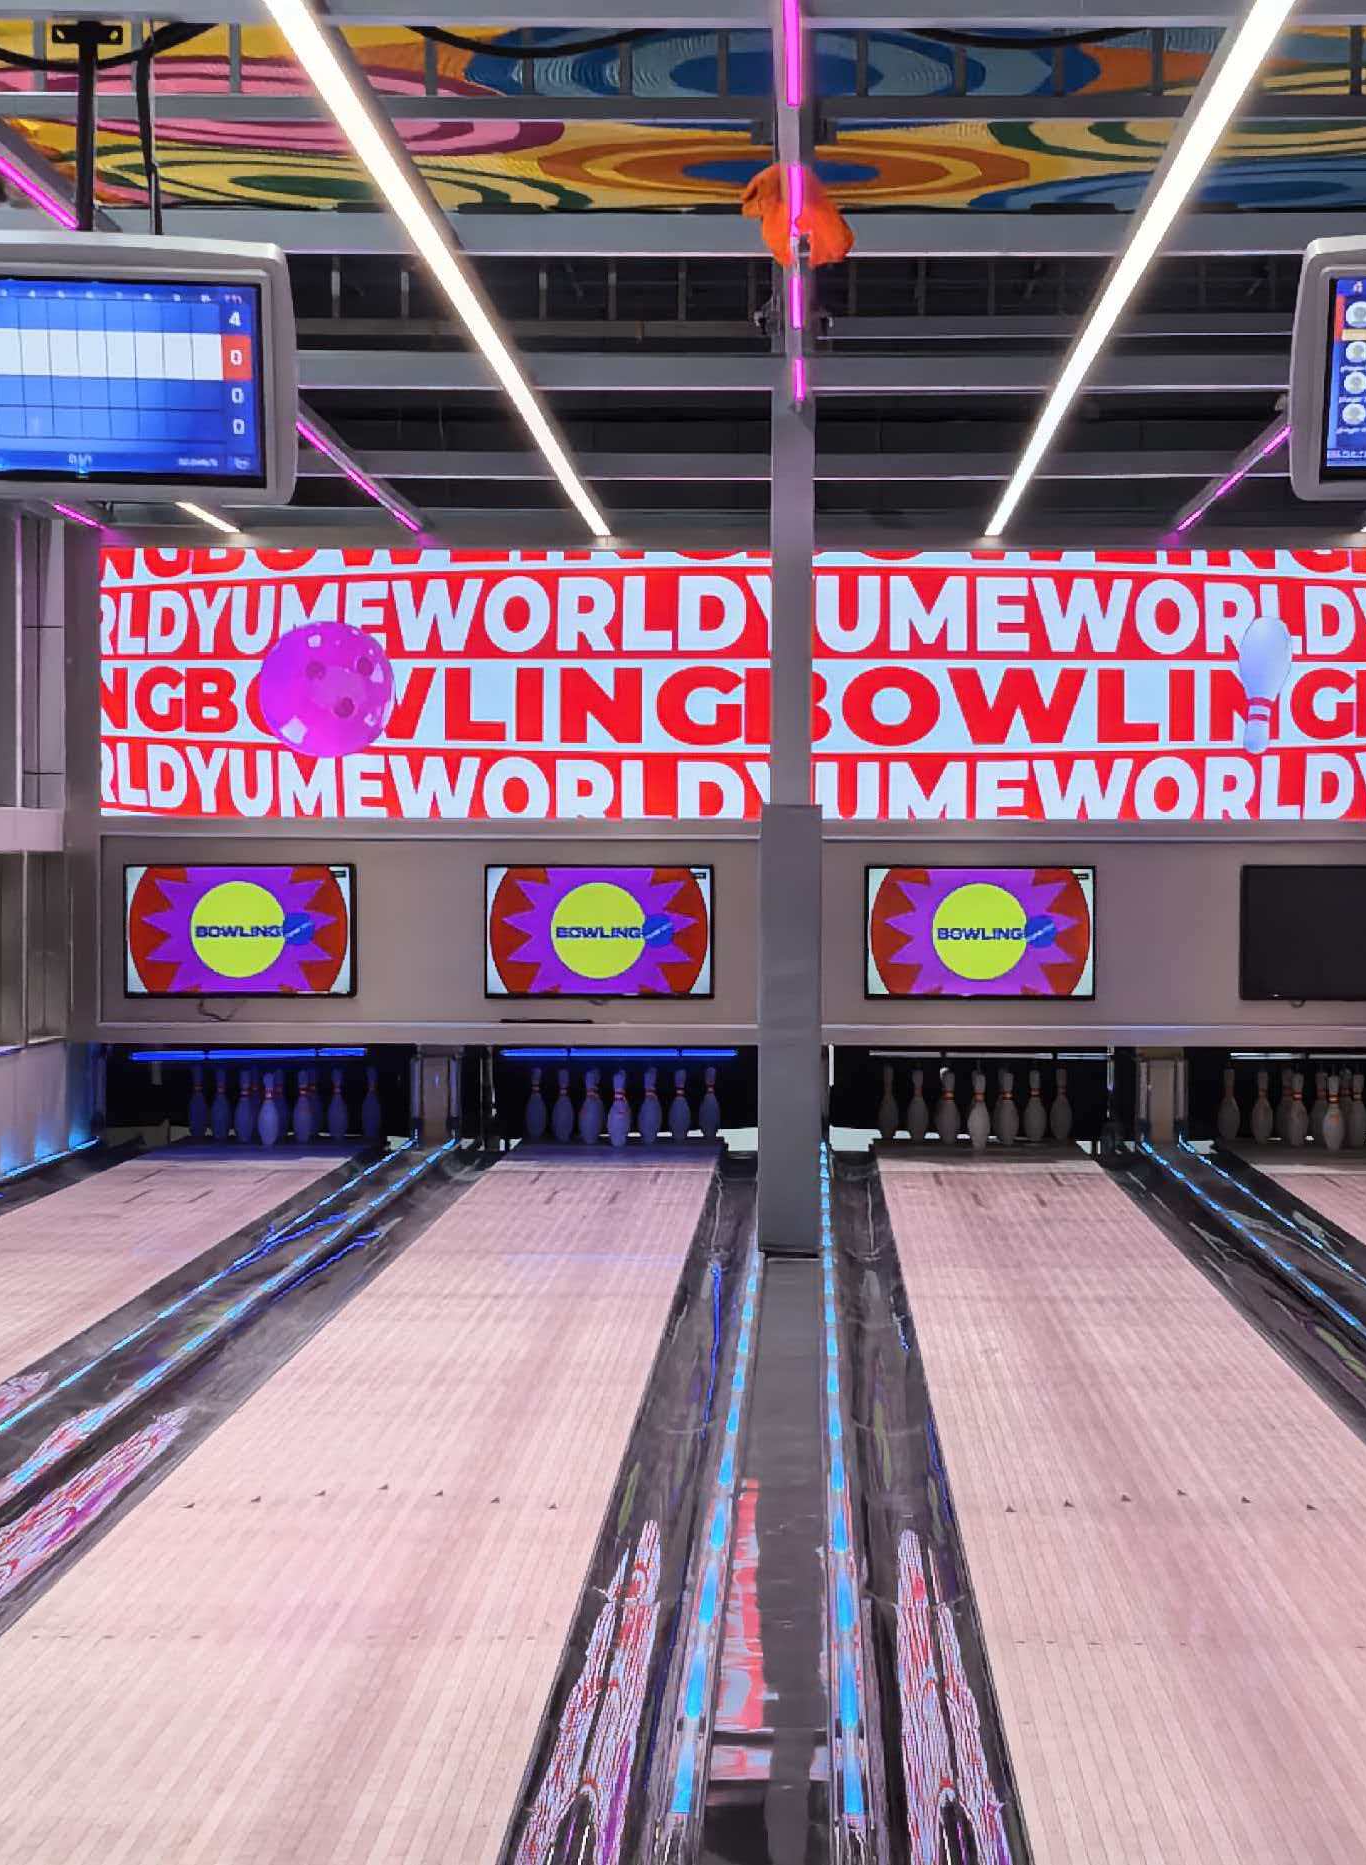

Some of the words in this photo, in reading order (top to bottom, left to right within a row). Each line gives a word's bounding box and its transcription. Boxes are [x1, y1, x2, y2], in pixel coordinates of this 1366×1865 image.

[229, 311, 241, 327] 4
[196, 925, 283, 938] BOWLING
[556, 926, 642, 939] BOWLING
[938, 927, 1025, 941] BOWLING
